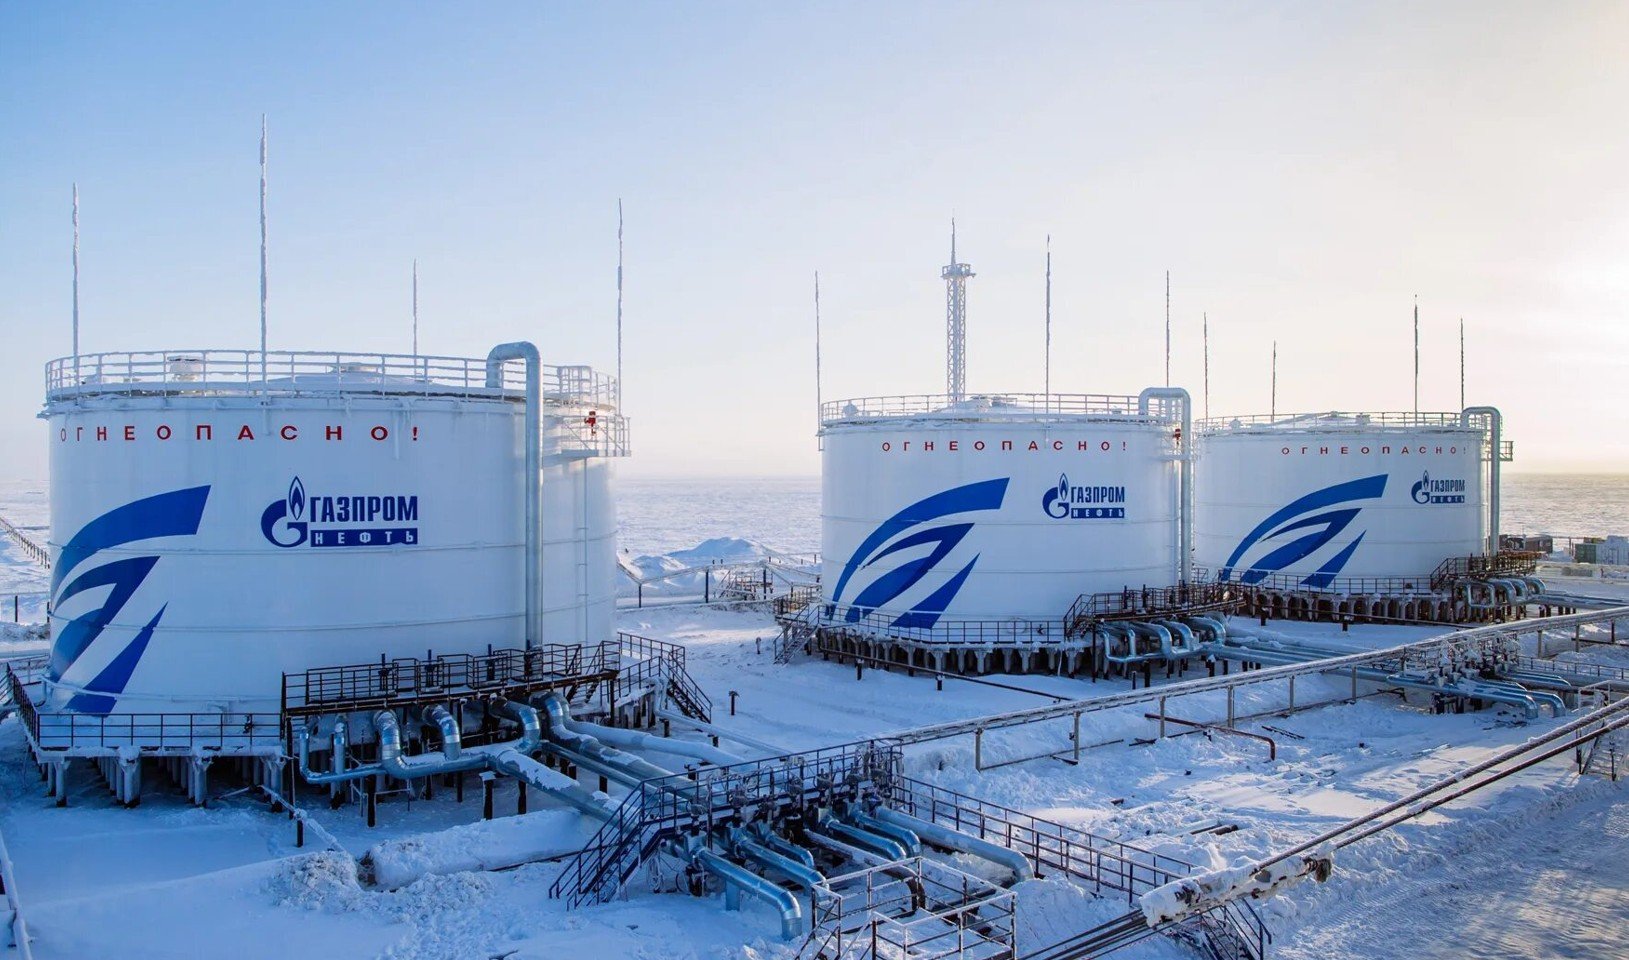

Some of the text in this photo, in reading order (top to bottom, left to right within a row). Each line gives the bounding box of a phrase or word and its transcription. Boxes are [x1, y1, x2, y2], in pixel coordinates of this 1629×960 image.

[60, 424, 420, 442] ОГНЕОПАСНО!
[881, 440, 1127, 452] ОГНЕОПАСНО!
[1430, 479, 1465, 492] ГАЗПРОМ
[1070, 486, 1125, 503] ГАЗПРОМ
[310, 496, 418, 522] ГАЗПРОМ
[314, 531, 415, 545] НЕФТЬ
